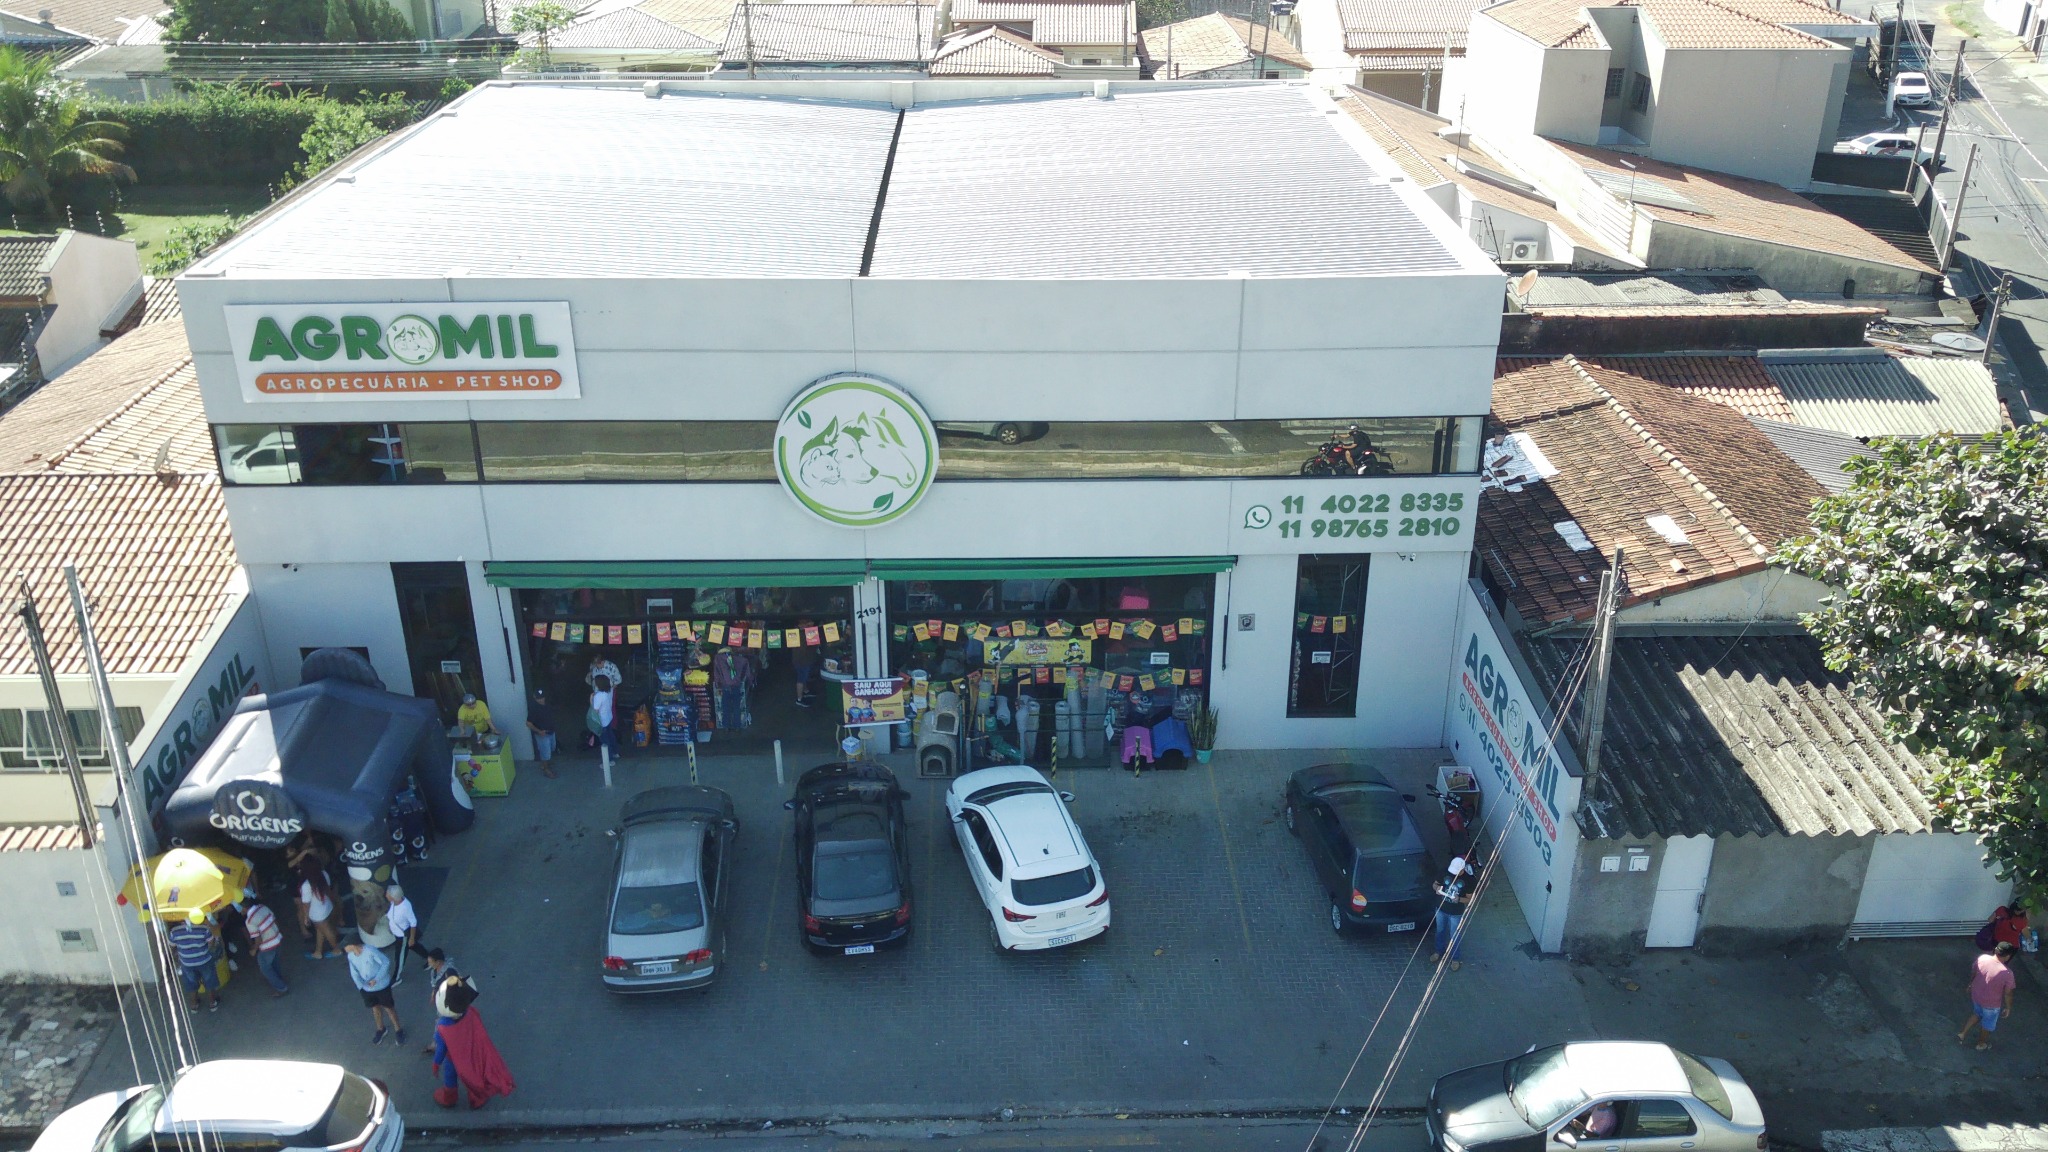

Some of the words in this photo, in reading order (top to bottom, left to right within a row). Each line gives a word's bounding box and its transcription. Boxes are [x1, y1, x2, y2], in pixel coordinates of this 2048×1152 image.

[266, 374, 429, 391] AGROPECUÁRIA
[499, 375, 554, 388] SHOP
[1281, 495, 1304, 514] 11
[1320, 493, 1391, 514] 4022
[1399, 492, 1464, 512] 8335
[1278, 519, 1302, 539] 11
[1310, 518, 1389, 538] 98765
[1398, 517, 1460, 537] 2810
[856, 605, 883, 619] 2191
[209, 812, 303, 834] ORIGENS
